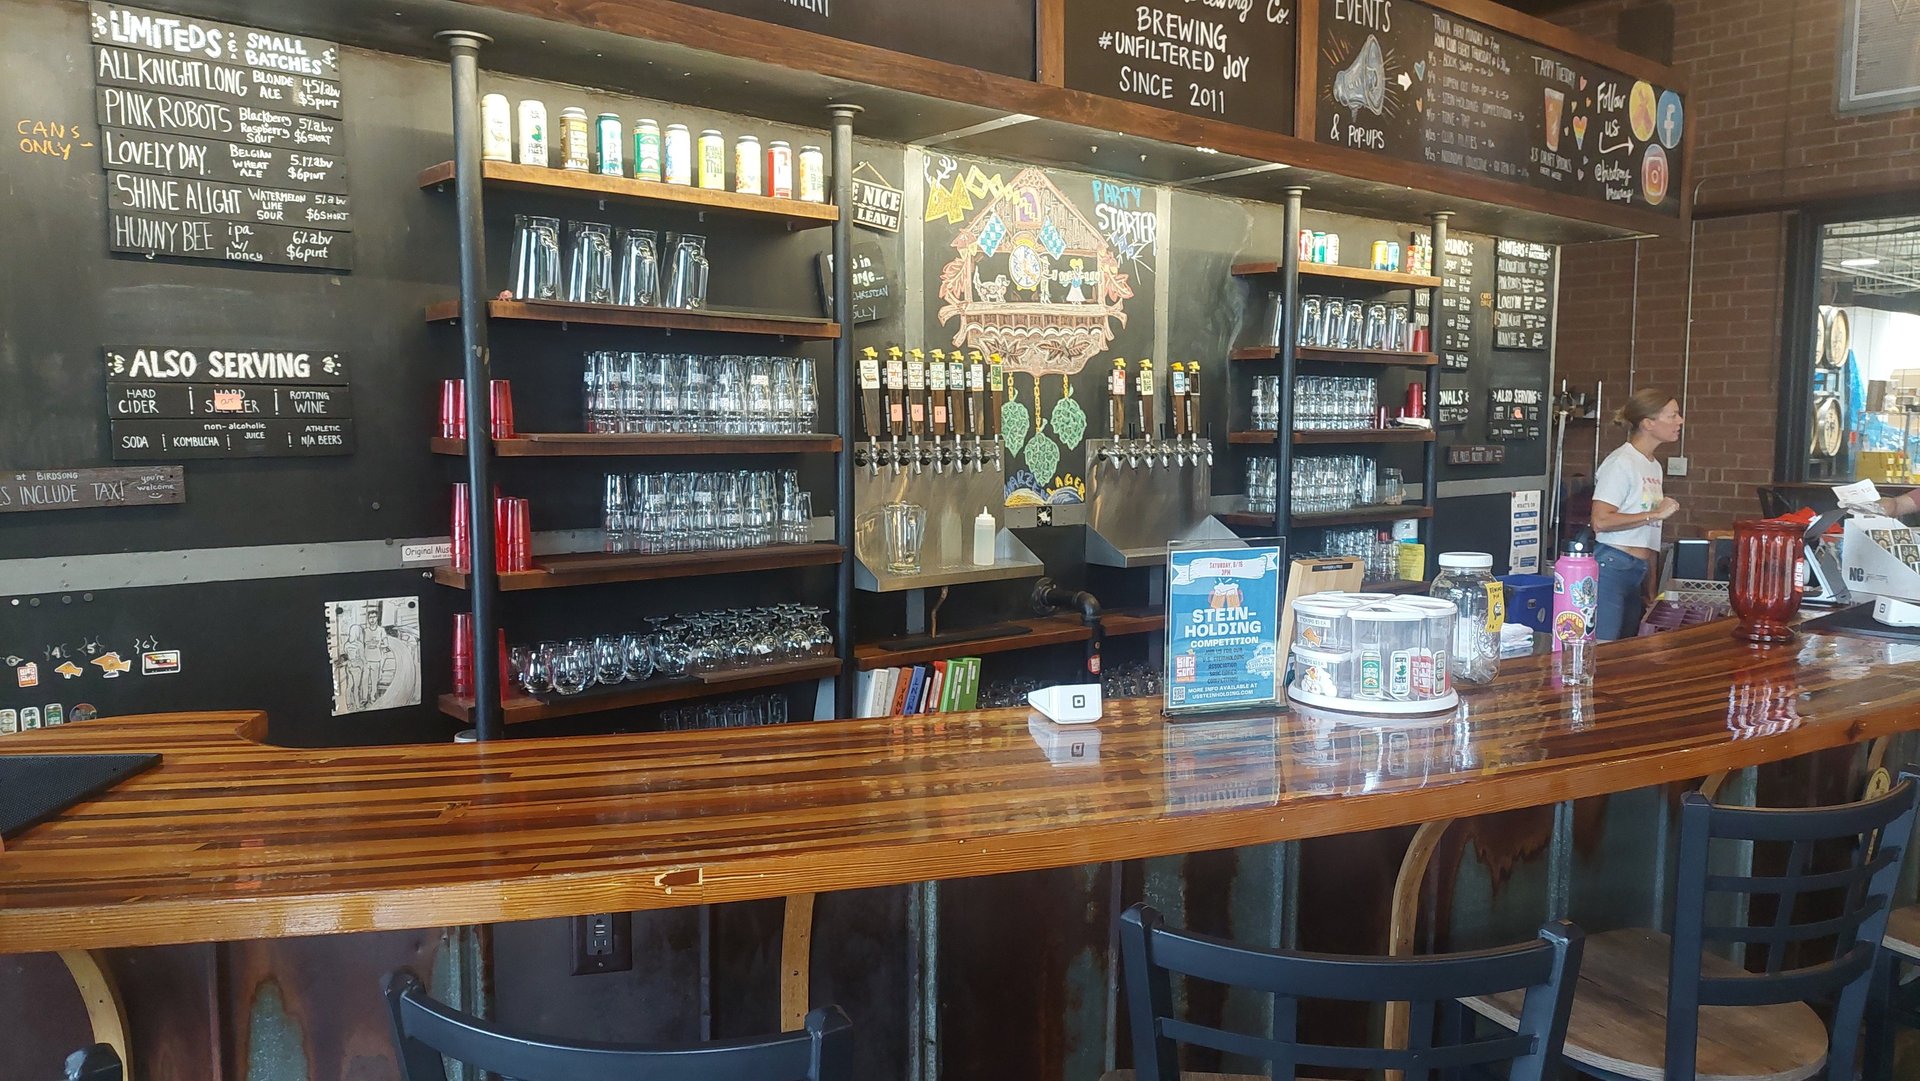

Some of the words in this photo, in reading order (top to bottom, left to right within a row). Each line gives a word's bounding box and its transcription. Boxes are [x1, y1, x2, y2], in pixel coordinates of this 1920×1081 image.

[1335, 0, 1392, 33] EVENTS
[109, 10, 222, 58] LIMITEDS
[1136, 6, 1228, 53] BREWING
[247, 33, 307, 55] SMALL
[245, 50, 322, 75] BATCHES
[1098, 30, 1215, 73] #UNFILTERED
[1223, 54, 1250, 82] JOY
[253, 70, 294, 87] BLONDE
[260, 85, 282, 99] ALE
[1119, 65, 1173, 99] SINCE
[1189, 83, 1225, 114] 2011
[1596, 81, 1626, 114] Follow
[106, 88, 156, 129] PINK
[158, 97, 233, 133] ROBOTS
[17, 119, 80, 139] CANS
[1604, 119, 1620, 137] us
[1348, 124, 1386, 150] POP-UPS
[19, 138, 71, 160] ONLY
[106, 131, 174, 171] LOVELY
[230, 143, 272, 159] BELGIAN
[232, 159, 269, 170] WHEAT
[239, 168, 263, 179] ALE
[116, 174, 180, 211] SHINE
[248, 187, 306, 203] WATERMELON
[863, 184, 900, 211] NICE
[1091, 179, 1142, 208] PARTY
[262, 201, 283, 211] LIME
[257, 210, 284, 221] SOUR
[857, 207, 897, 228] LEAVE
[115, 215, 178, 252] HUNNY
[182, 221, 215, 252] BEE
[228, 222, 254, 237] ipa
[1095, 203, 1157, 256] STARTER
[232, 241, 249, 251] w/
[226, 247, 263, 262] honey
[859, 255, 872, 268] in
[129, 349, 198, 378] ALSO
[208, 350, 311, 380] SERVING
[126, 389, 156, 399] HARD
[289, 391, 330, 401] ROTATING
[118, 399, 160, 414] CIDER
[294, 403, 327, 414] WINE
[203, 422, 267, 431] non-alcoholic
[122, 436, 150, 449] SODA
[172, 436, 220, 448] KOMBUCHA
[244, 431, 266, 440] JUICE
[301, 436, 316, 448] N/A
[317, 435, 342, 446] BEERS
[16, 473, 26, 481] at
[36, 472, 79, 481] BIRDSONG
[141, 474, 165, 484] you're
[0, 486, 11, 506] S
[19, 484, 79, 505] INCLUDE
[90, 481, 125, 501] TAX!
[137, 484, 175, 492] welcome
[405, 546, 433, 558] Original
[1849, 567, 1864, 582] NC
[1192, 606, 1257, 624] STEIN-
[1184, 621, 1262, 638] HOLDING
[86, 642, 97, 654] 5
[1190, 636, 1259, 648] COMPETITION
[51, 646, 60, 659] 4
